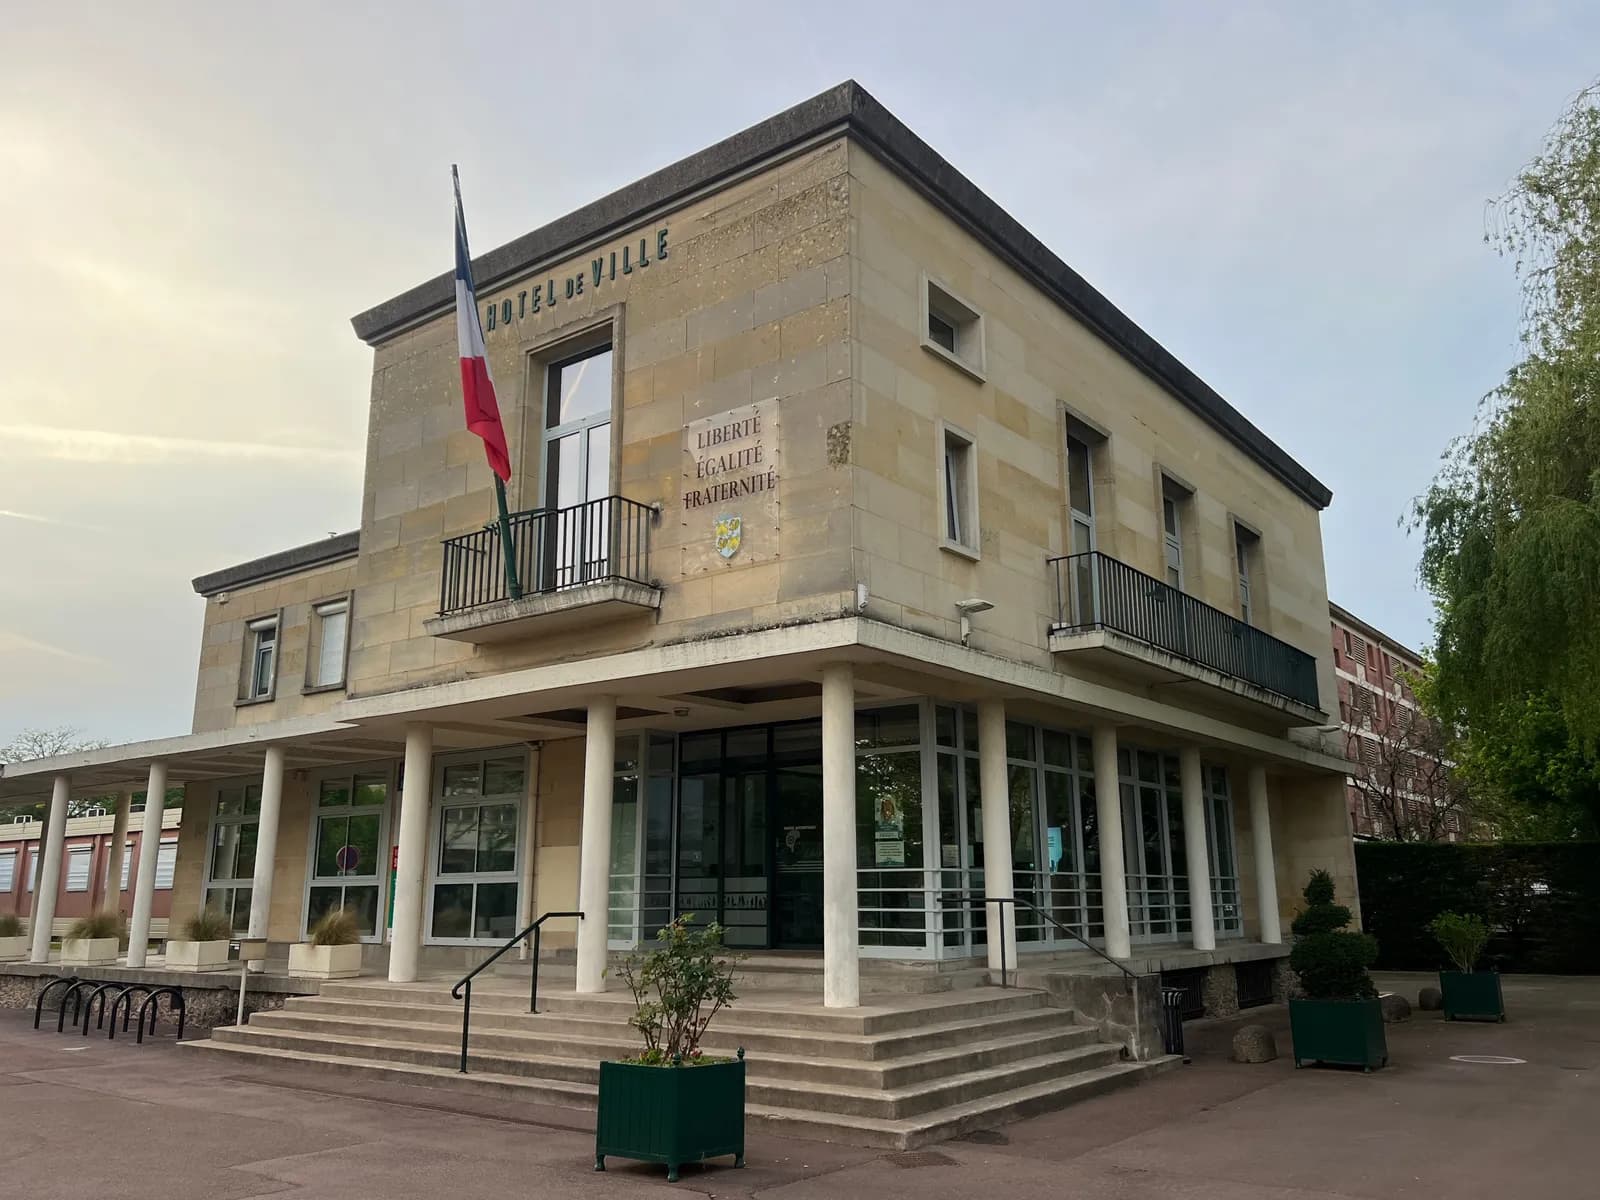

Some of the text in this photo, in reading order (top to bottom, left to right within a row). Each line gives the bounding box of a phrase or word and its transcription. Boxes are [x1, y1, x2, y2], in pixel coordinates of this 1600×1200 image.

[487, 228, 668, 331] HOTEL DE VILLE
[697, 410, 761, 449] LIBERTÉ
[696, 439, 763, 479] ÉGALITÉ
[684, 464, 775, 509] FRATERNITÉ
